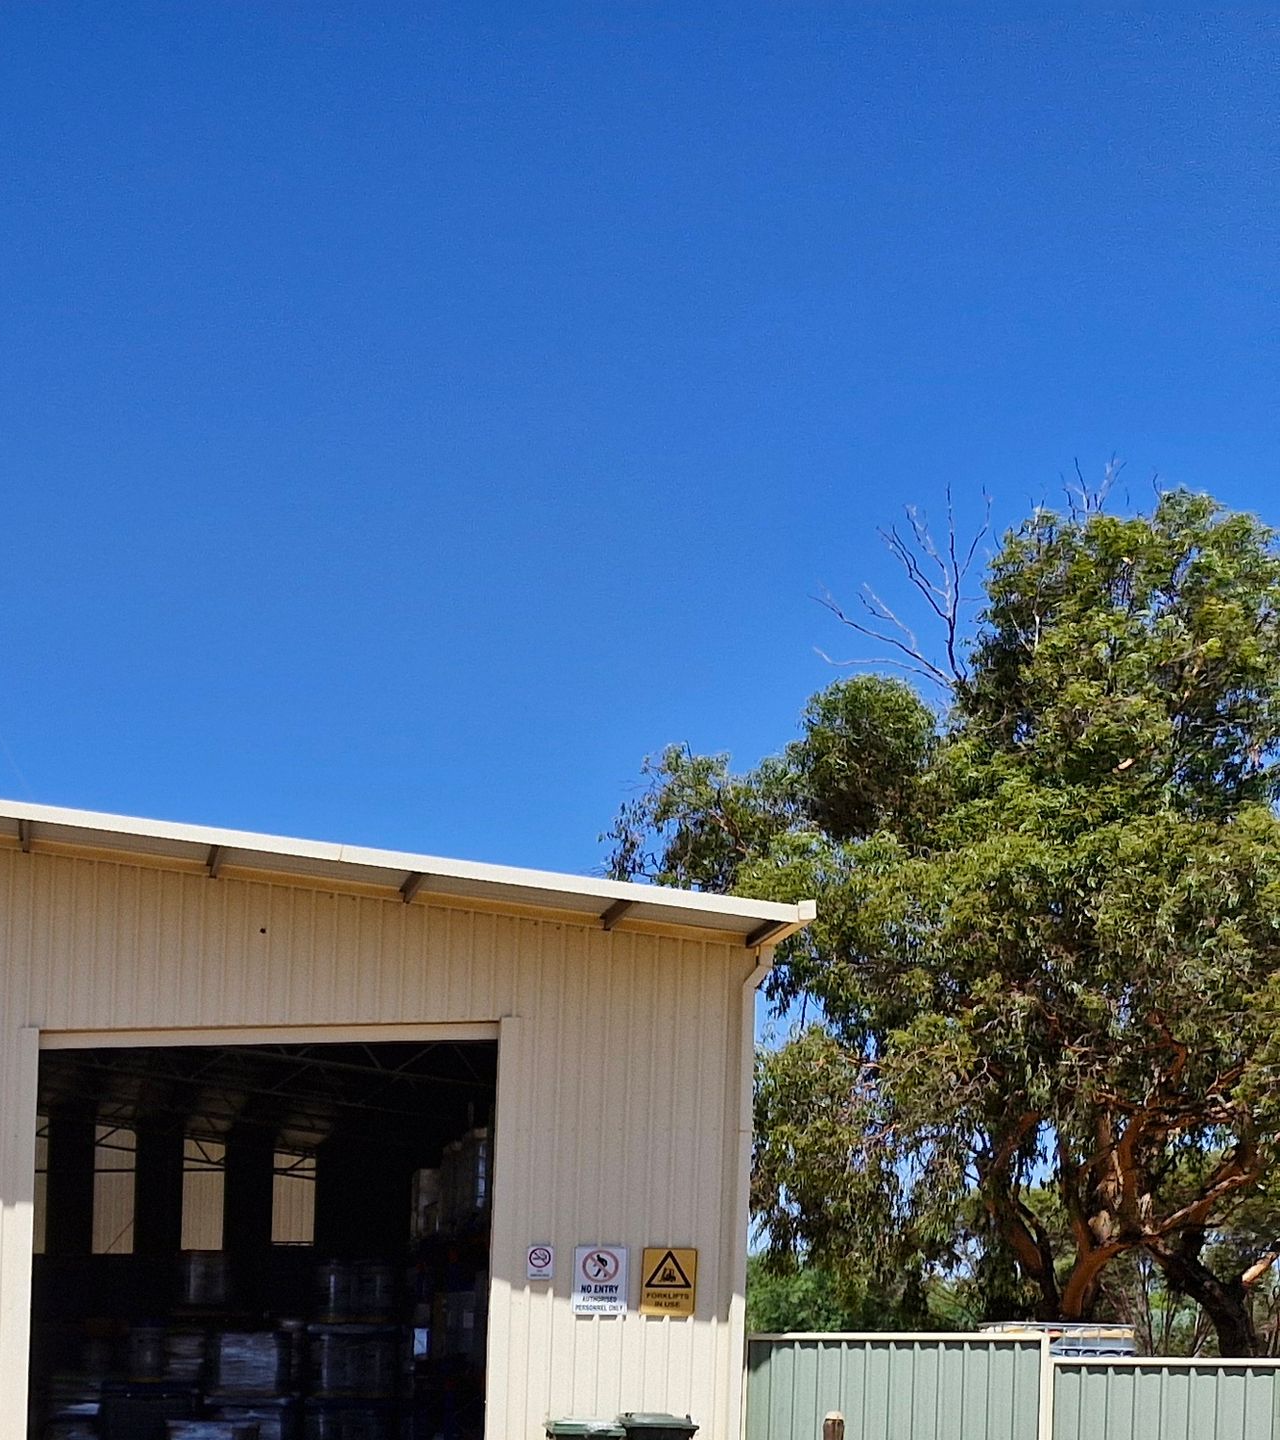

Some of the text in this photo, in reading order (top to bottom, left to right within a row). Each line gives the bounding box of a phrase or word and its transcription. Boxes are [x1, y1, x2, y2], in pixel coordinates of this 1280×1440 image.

[581, 1284, 619, 1294] NO ENTRY
[646, 1292, 690, 1300] FORKLIFTS
